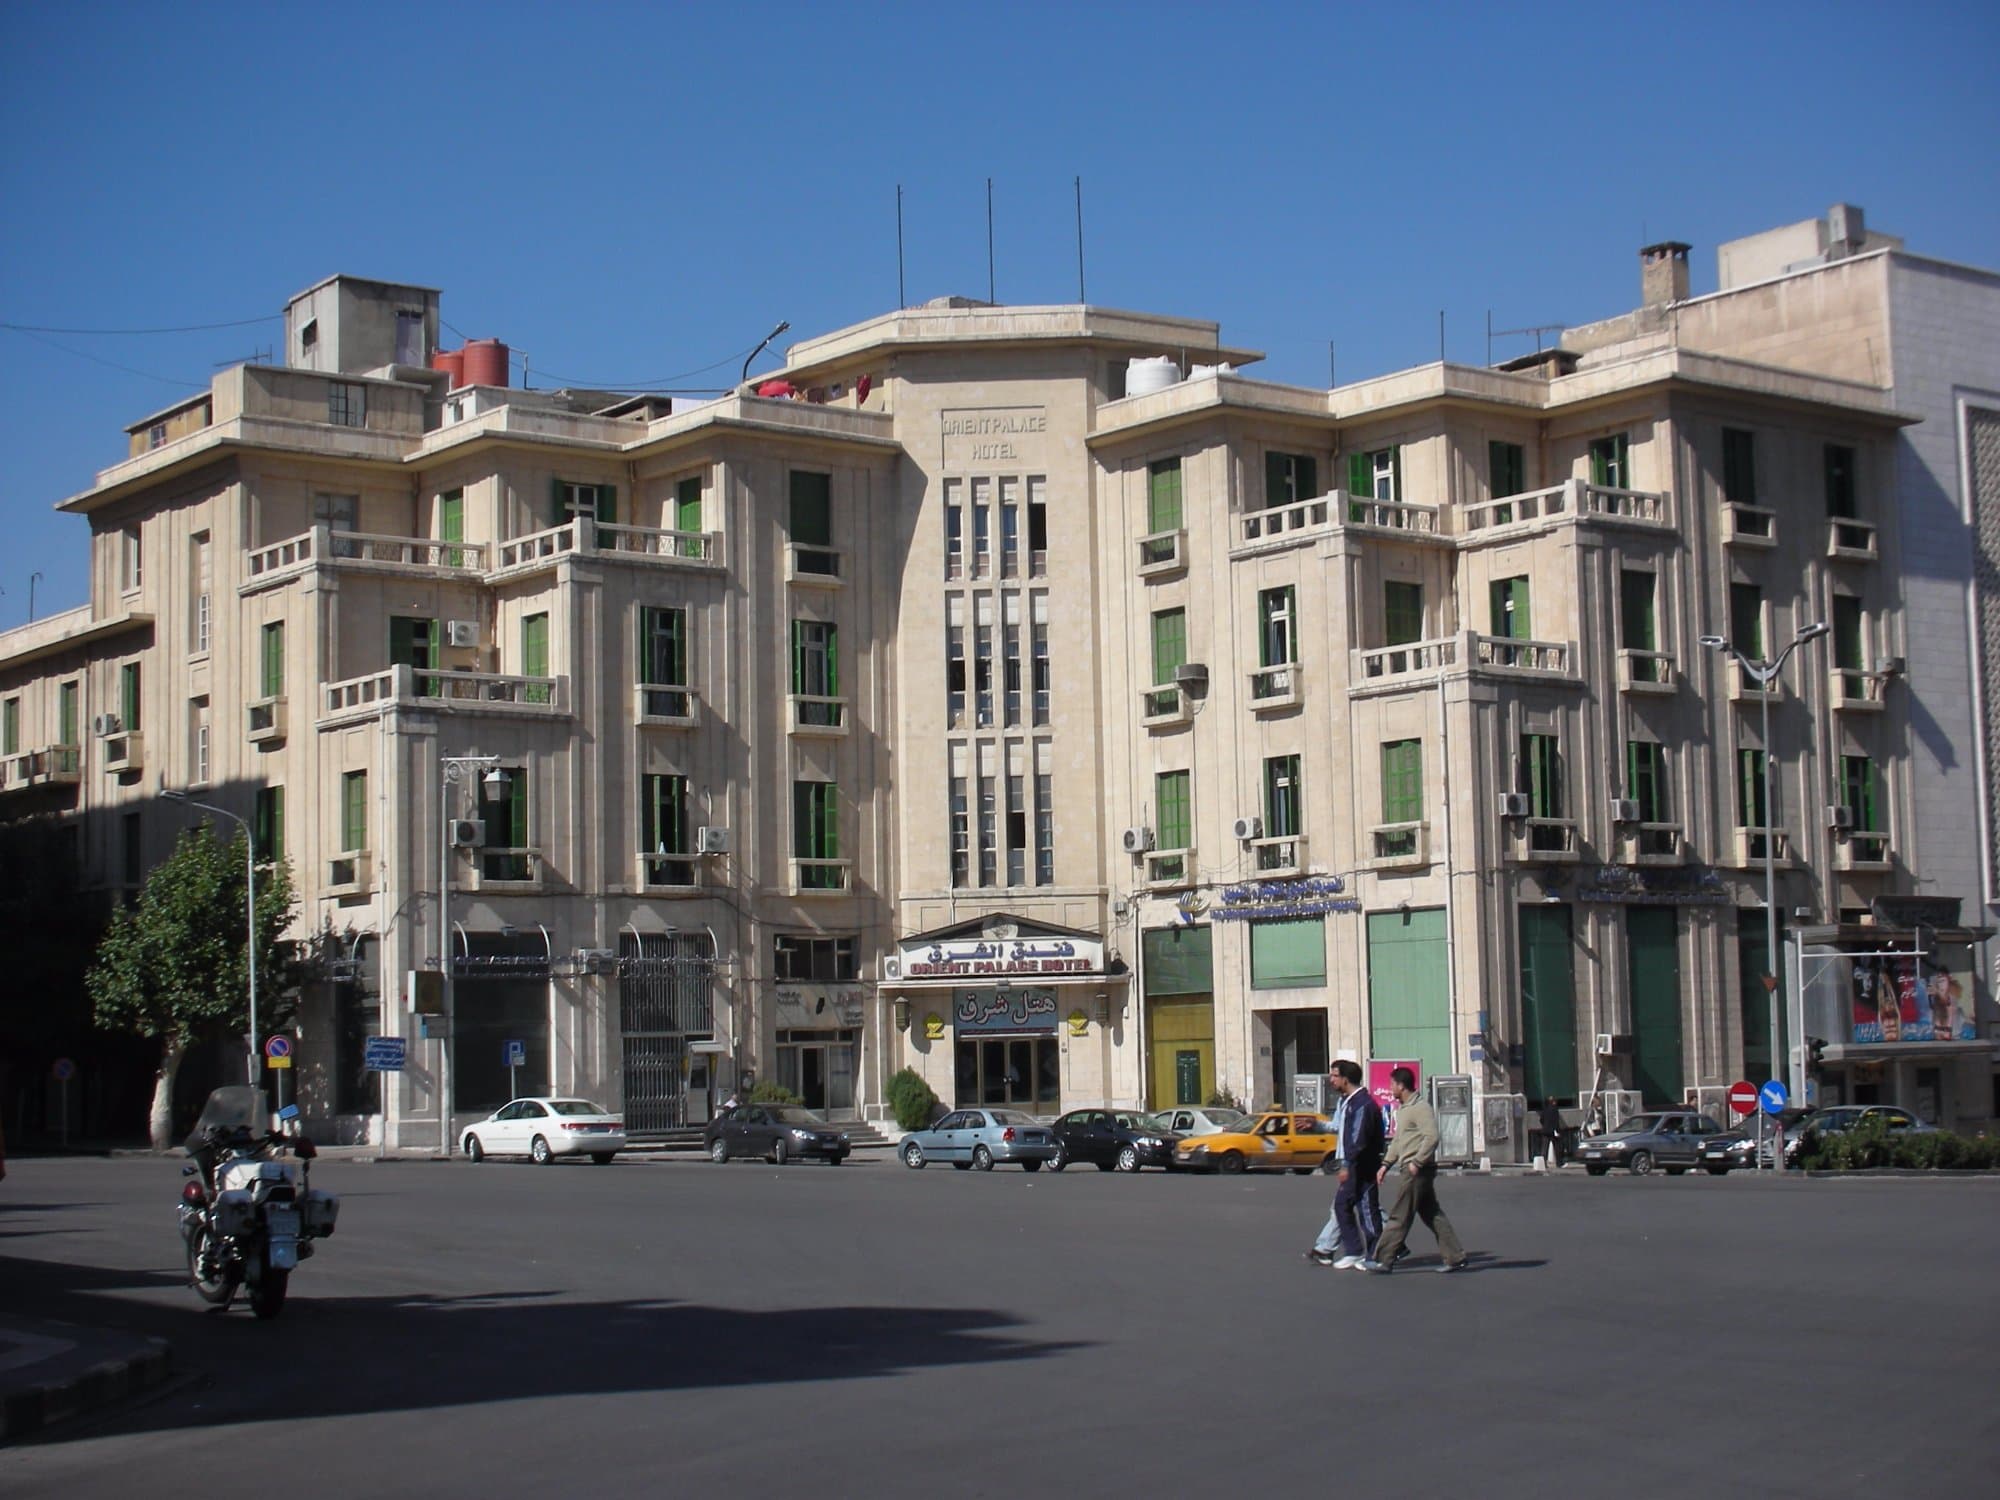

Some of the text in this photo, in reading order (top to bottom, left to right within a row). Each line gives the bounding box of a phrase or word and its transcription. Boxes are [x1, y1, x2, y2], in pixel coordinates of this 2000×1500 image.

[973, 442, 1017, 459] HOTEL
[928, 941, 1075, 963] فندق الشرق
[911, 958, 1093, 975] ORIENT PALACE HOTEL
[958, 991, 1056, 1025] هتل شرق
